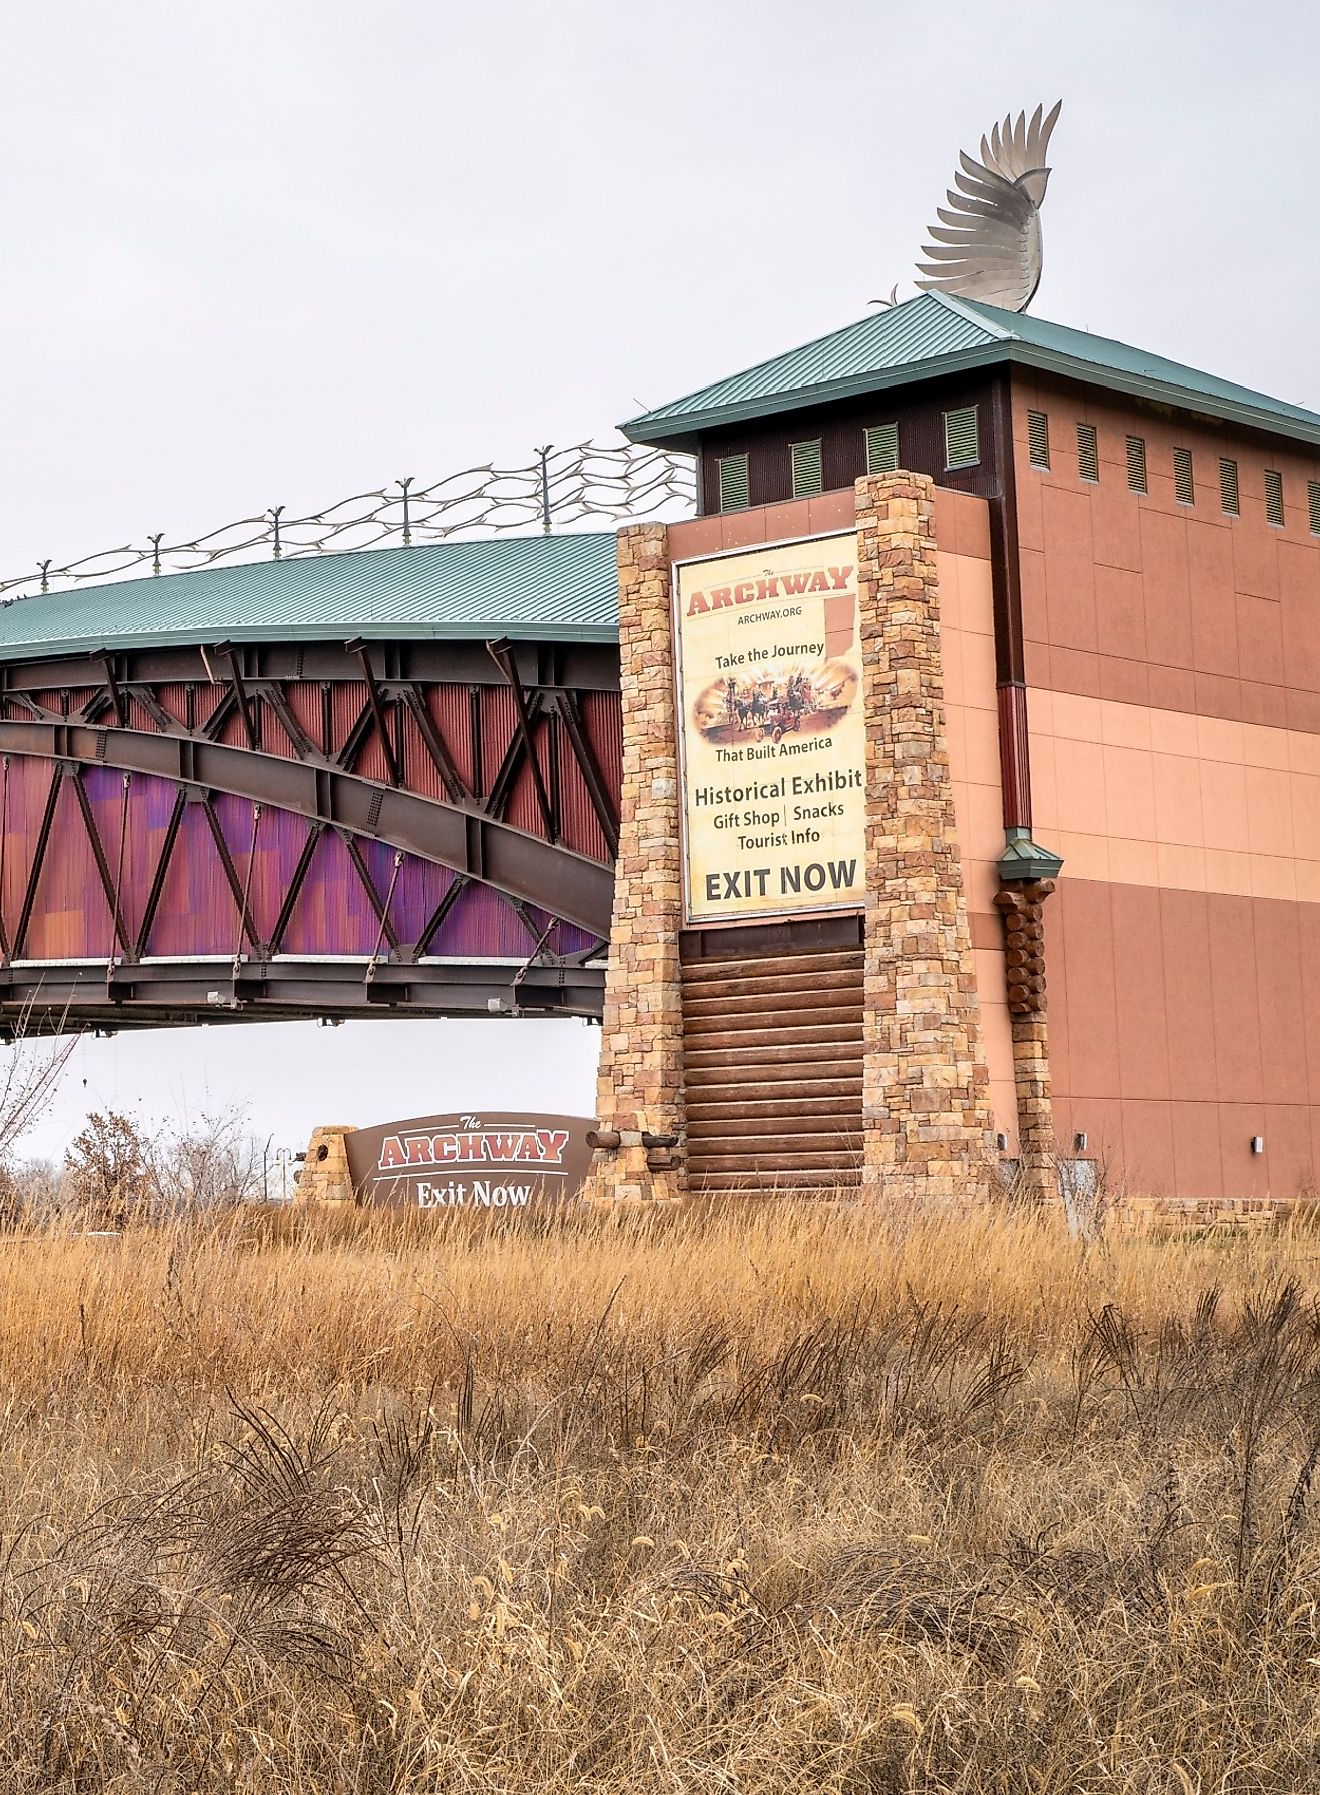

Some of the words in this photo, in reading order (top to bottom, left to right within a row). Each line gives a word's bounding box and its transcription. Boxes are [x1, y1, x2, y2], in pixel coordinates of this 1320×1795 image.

[686, 565, 854, 616] ARCHWAY
[737, 606, 803, 625] ARCHWAY.ORG
[715, 654, 745, 669] Take
[748, 648, 769, 662] the
[771, 642, 824, 659] Journey
[716, 749, 744, 762] That
[746, 745, 776, 761] Built
[779, 737, 833, 757] America
[695, 777, 786, 807] Historical
[792, 769, 862, 796] Exhibit
[713, 813, 740, 829] Gift
[743, 810, 780, 828] Shop
[793, 801, 845, 821] Snacks
[738, 832, 788, 850] Tourist
[791, 827, 821, 845] Info
[705, 869, 771, 901] EXIT
[780, 859, 857, 895] NOW
[459, 1115, 481, 1130] The
[378, 1129, 569, 1170] ARCHWAY
[416, 1181, 467, 1208] Exit
[472, 1180, 531, 1207] Now
